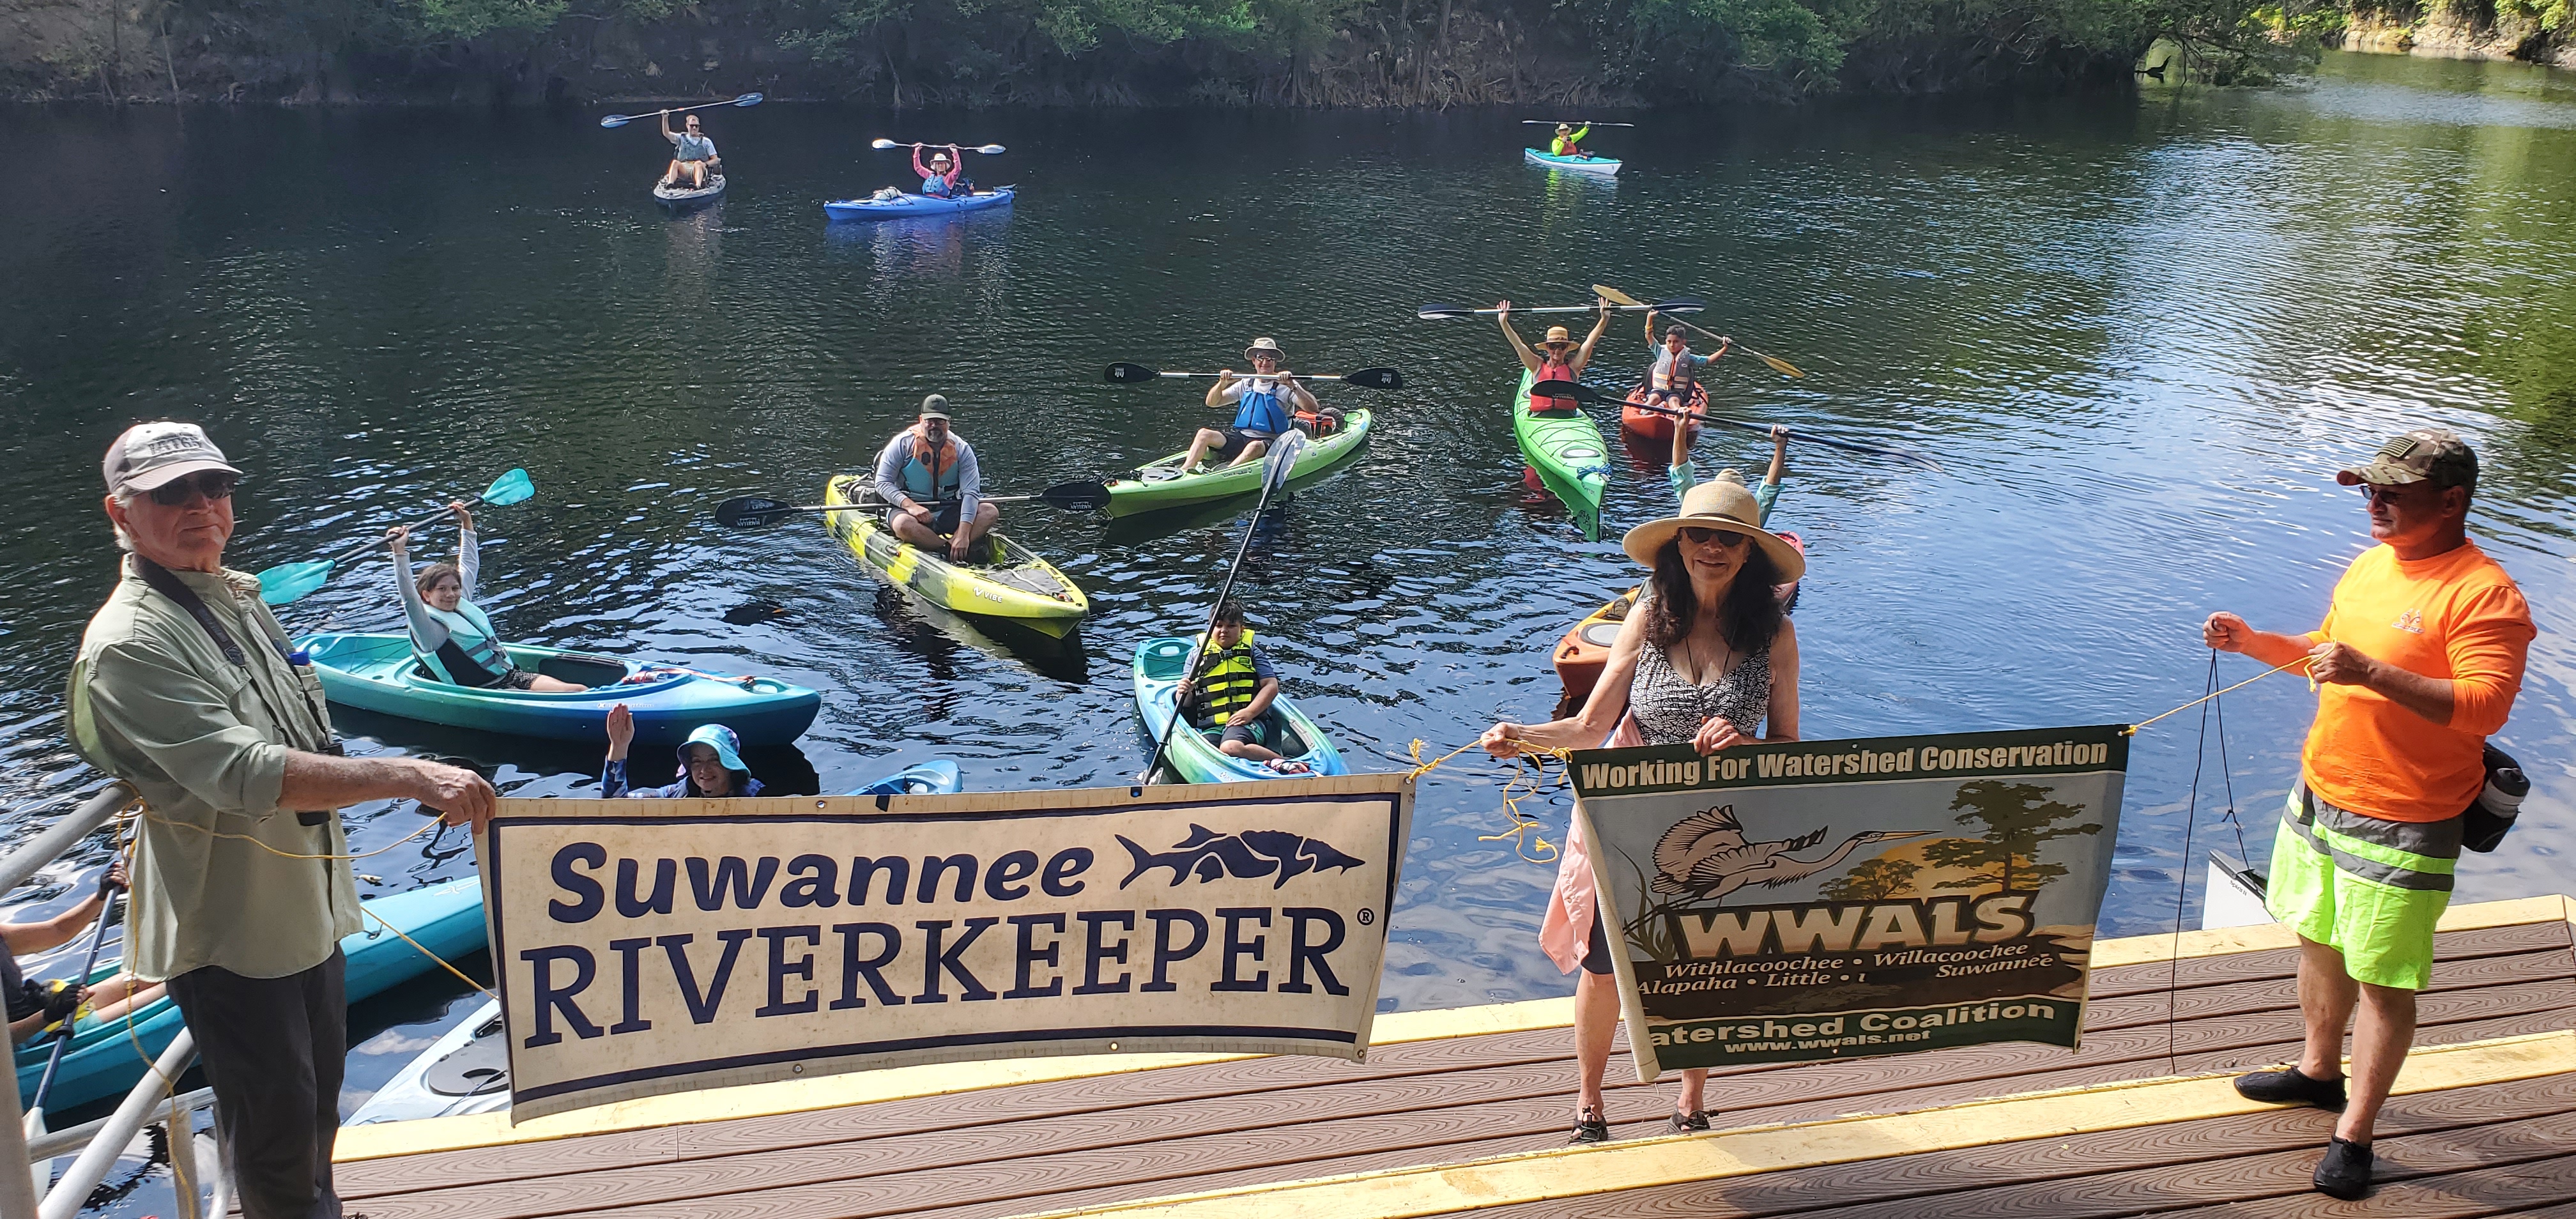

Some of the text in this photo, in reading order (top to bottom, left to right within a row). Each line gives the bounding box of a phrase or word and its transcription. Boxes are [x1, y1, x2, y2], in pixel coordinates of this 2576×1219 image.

[985, 591, 1002, 603] VIBE
[1581, 740, 2108, 790] Working For Watershed Conservation
[548, 841, 1094, 924] Suwannee
[1679, 896, 2027, 958] WWALS
[1637, 977, 1738, 995] Alapaha
[1764, 971, 1832, 987] Little
[1936, 954, 2054, 978] Suwannee
[1664, 956, 1844, 979] Withlacoochee
[1874, 944, 2028, 967] Willacoochee
[1650, 1002, 2054, 1046] atershed Coalition
[1724, 1030, 1930, 1054] www.wwals.net
